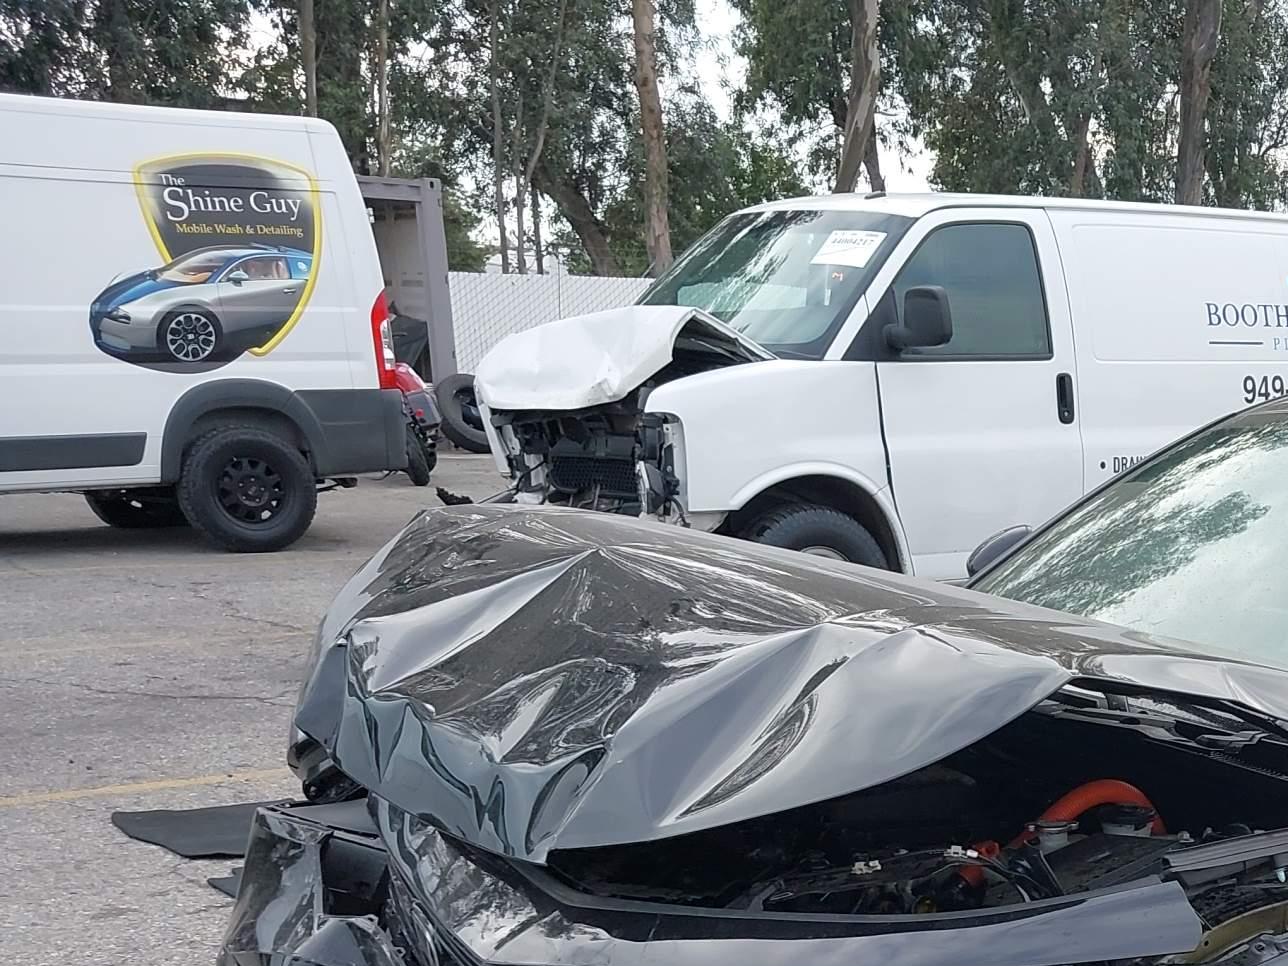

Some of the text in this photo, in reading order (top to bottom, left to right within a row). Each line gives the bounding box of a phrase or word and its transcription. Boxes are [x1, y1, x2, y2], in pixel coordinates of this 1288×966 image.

[160, 173, 185, 186] The
[163, 187, 302, 222] Shine Guy
[175, 223, 304, 238] Mobile Wash & Detailing
